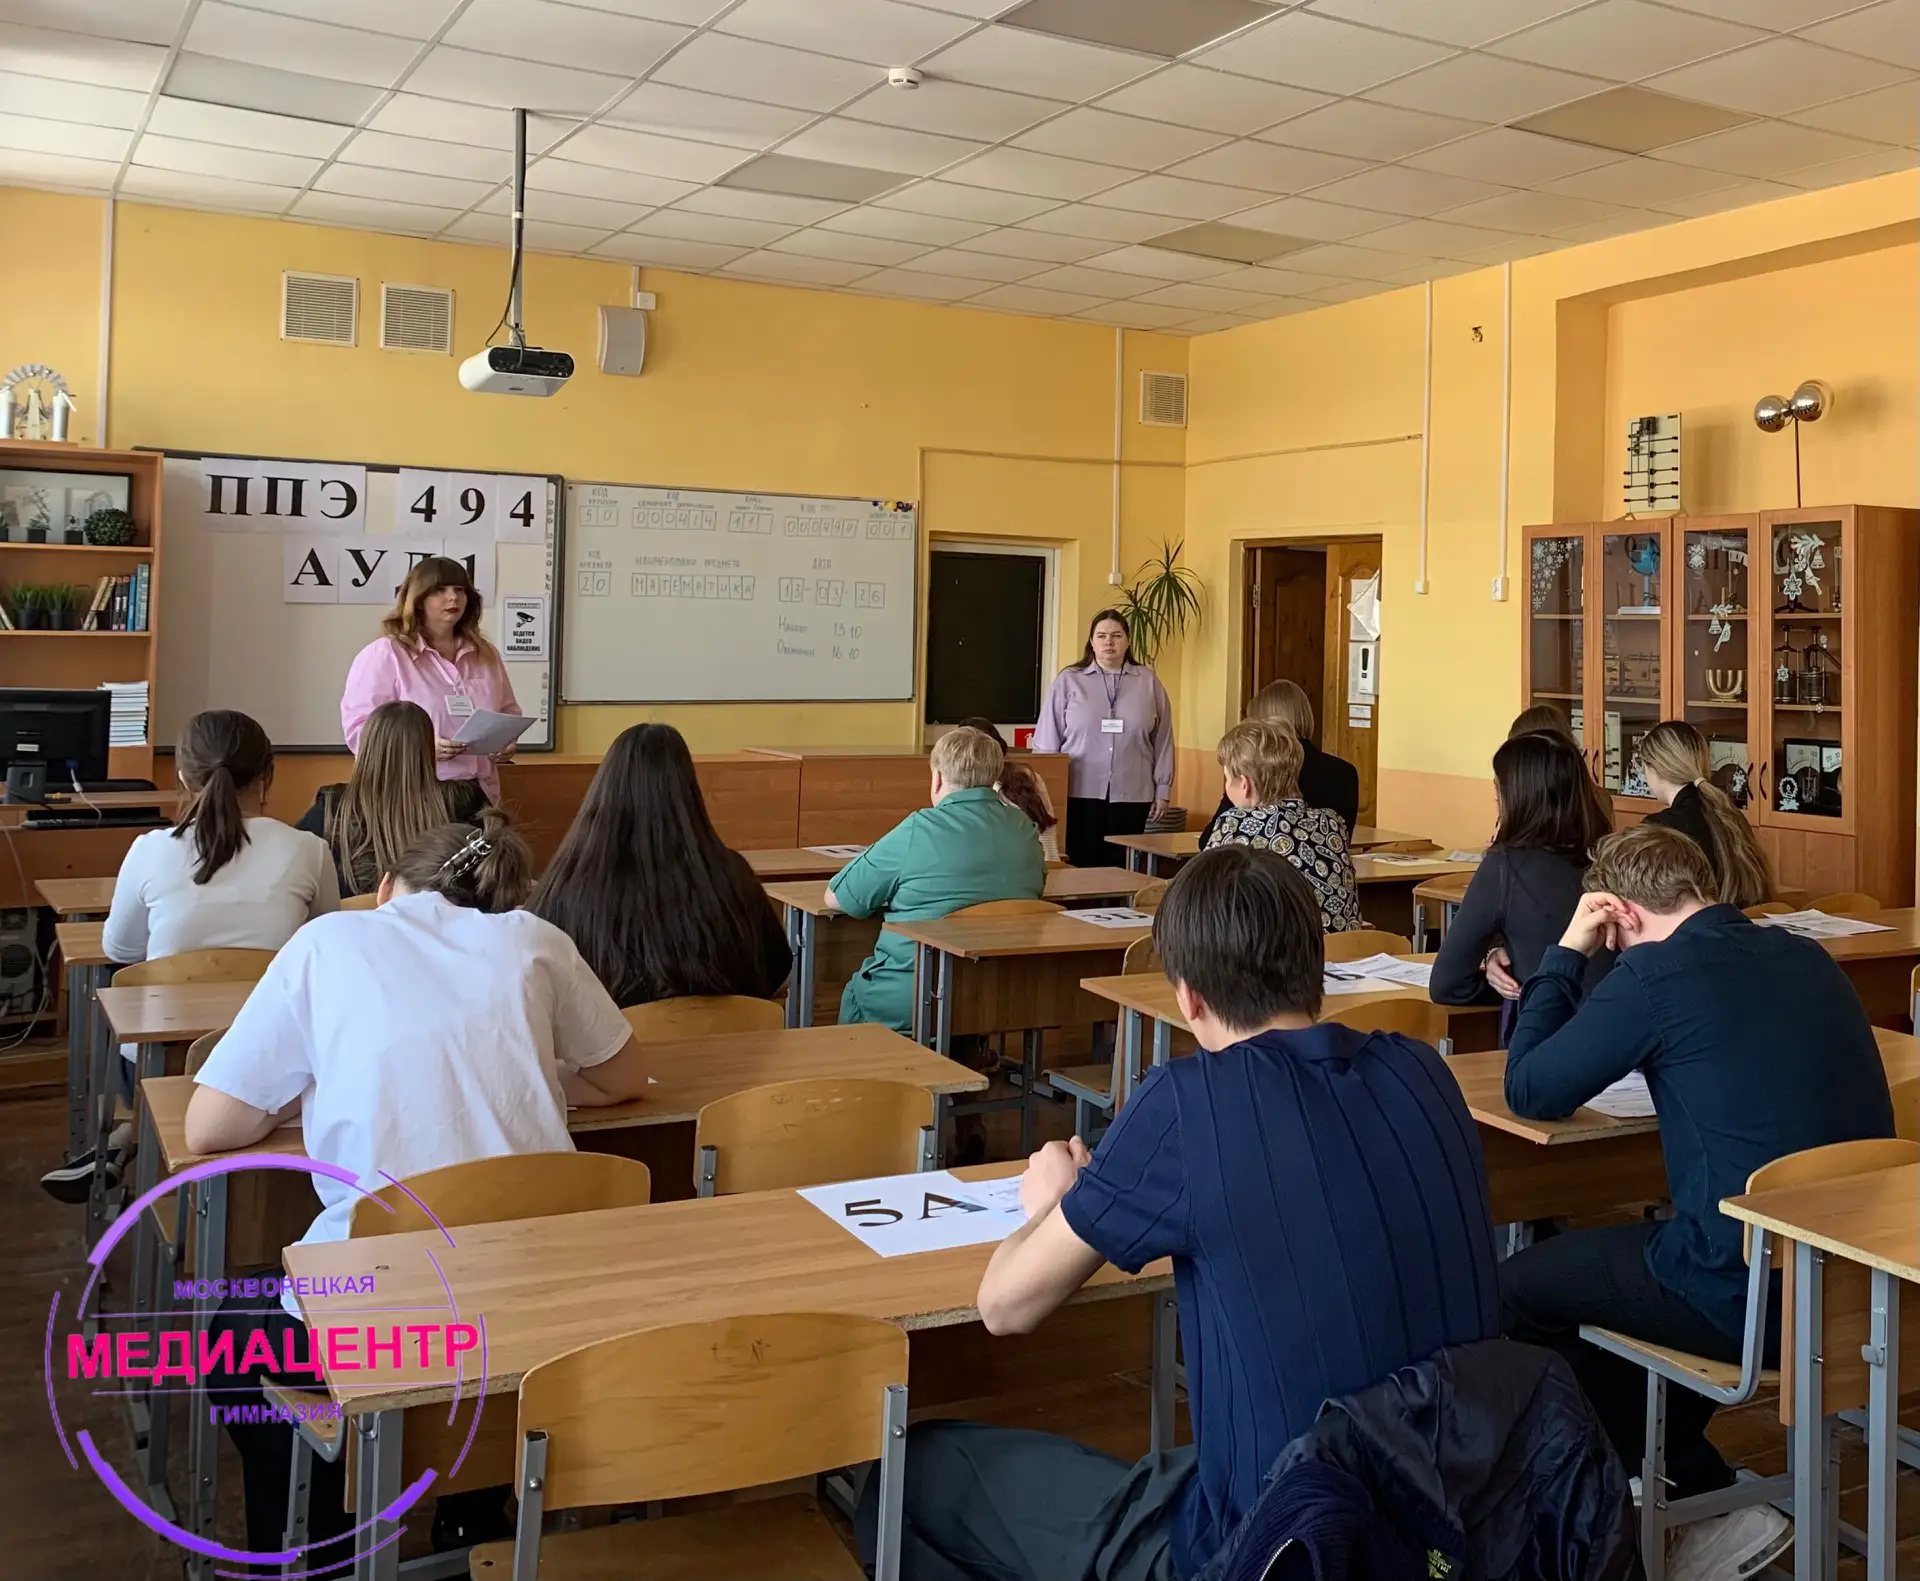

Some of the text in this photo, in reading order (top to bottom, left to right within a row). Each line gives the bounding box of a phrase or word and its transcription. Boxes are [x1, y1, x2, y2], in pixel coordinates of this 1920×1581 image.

[204, 473, 535, 528] ППЭ 494
[634, 576, 753, 596] МАТЕМАТИКА
[844, 1191, 989, 1228] 5А
